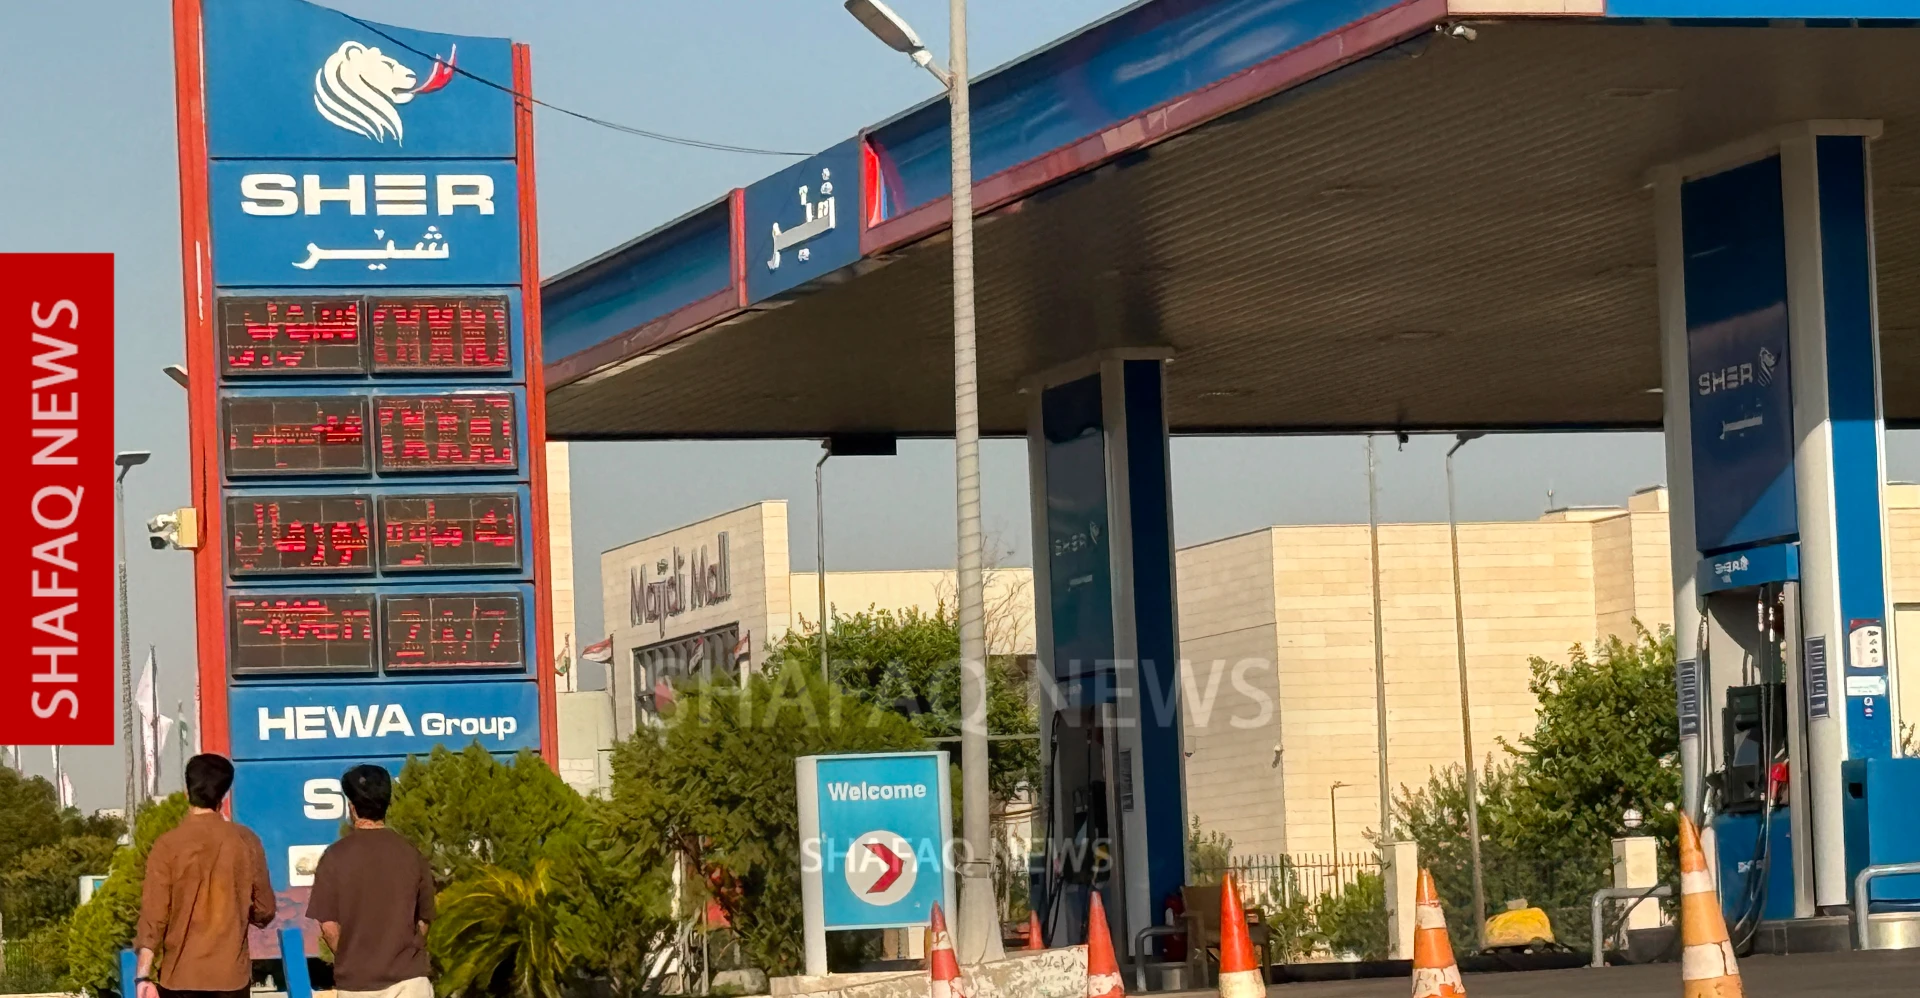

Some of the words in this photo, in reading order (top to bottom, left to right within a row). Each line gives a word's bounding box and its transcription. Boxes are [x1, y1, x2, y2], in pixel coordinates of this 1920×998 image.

[241, 173, 495, 216] SHER
[1698, 362, 1754, 396] SHER
[690, 530, 731, 612] Mall
[258, 704, 415, 741] HEWA
[420, 712, 517, 741] Group
[827, 782, 927, 801] Welcome
